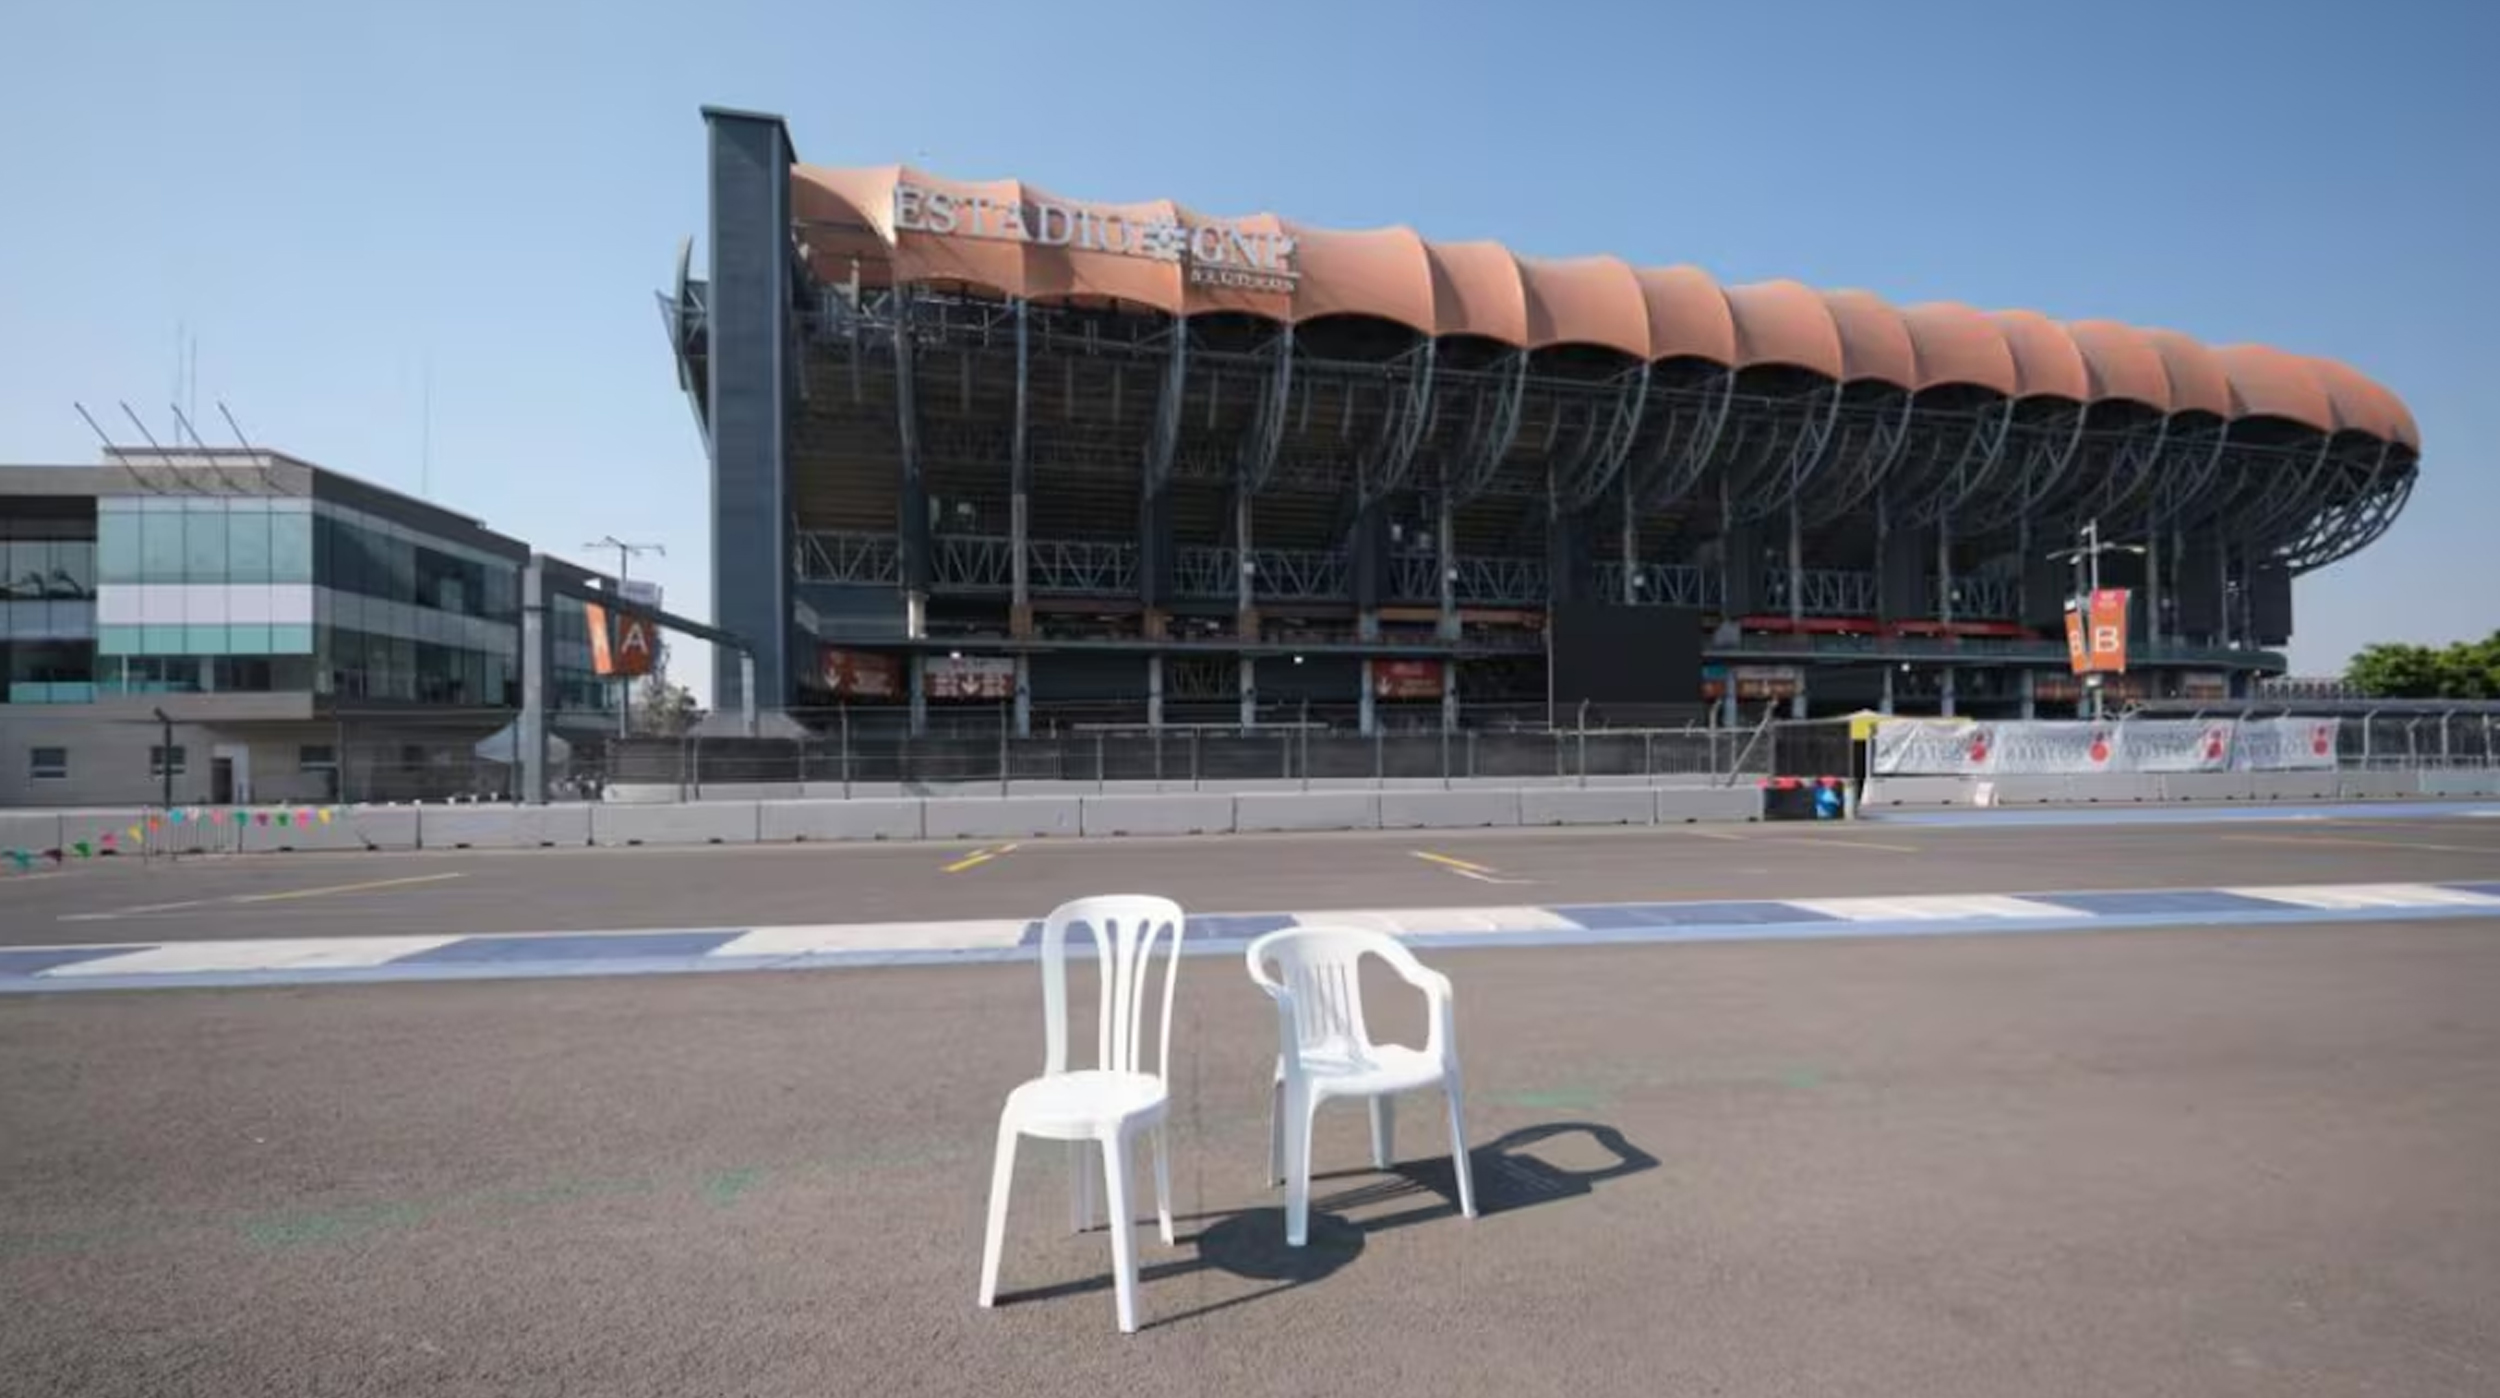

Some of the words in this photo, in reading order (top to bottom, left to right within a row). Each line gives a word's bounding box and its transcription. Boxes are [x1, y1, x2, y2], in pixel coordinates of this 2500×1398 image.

[894, 186, 1133, 254] ESTADIO
[1192, 225, 1297, 271] GNP
[621, 622, 649, 655] A
[2095, 626, 2119, 652] B
